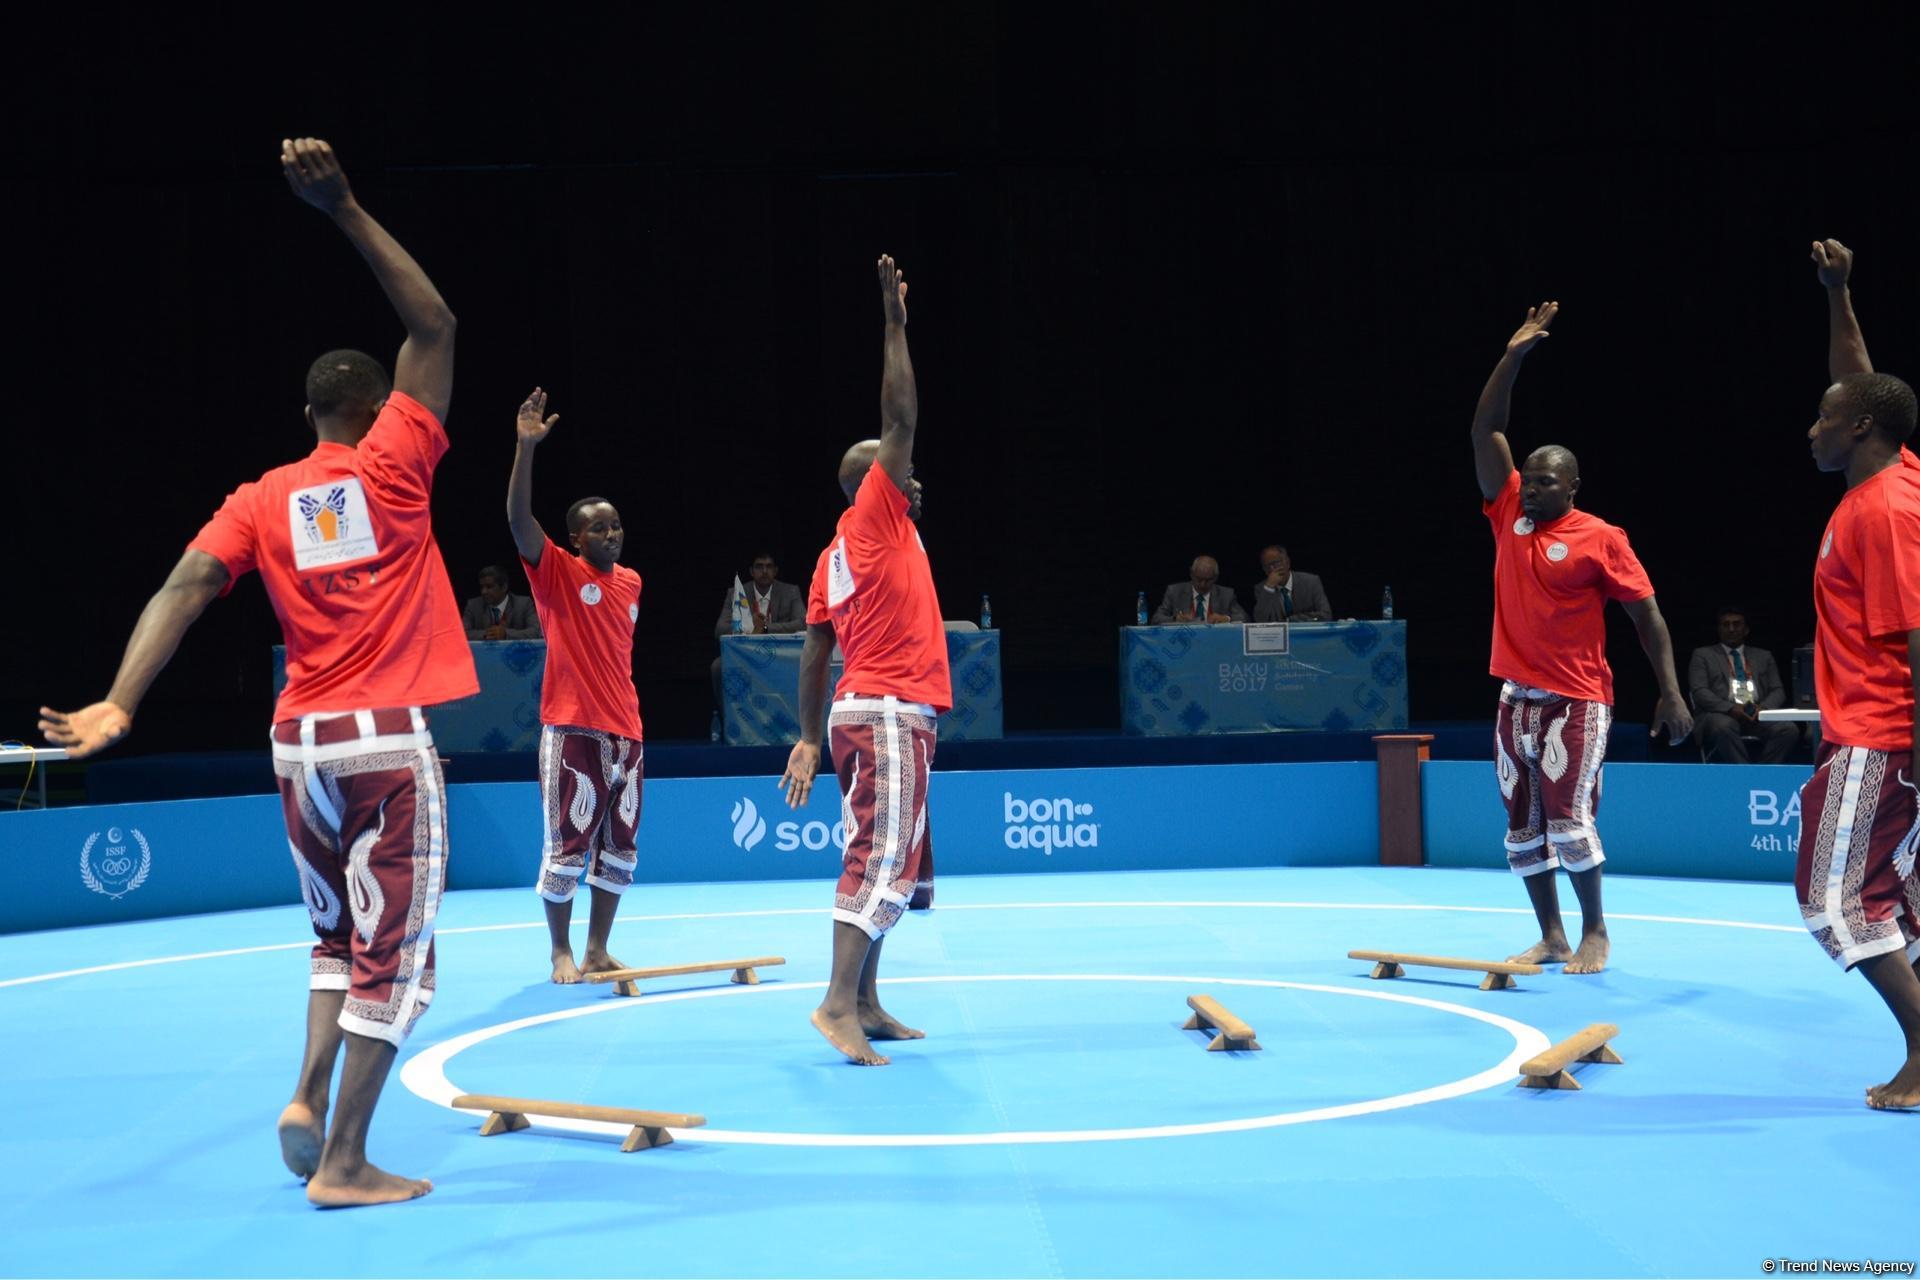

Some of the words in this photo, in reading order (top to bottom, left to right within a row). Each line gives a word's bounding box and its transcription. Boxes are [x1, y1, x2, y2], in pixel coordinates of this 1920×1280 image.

[1219, 662, 1268, 678] BAKU
[1219, 677, 1268, 692] 2017
[1004, 792, 1074, 823] bon
[1748, 790, 1801, 825] BA
[1004, 823, 1098, 856] aqua
[1750, 833, 1782, 851] 4th
[105, 845, 127, 857] ISSF
